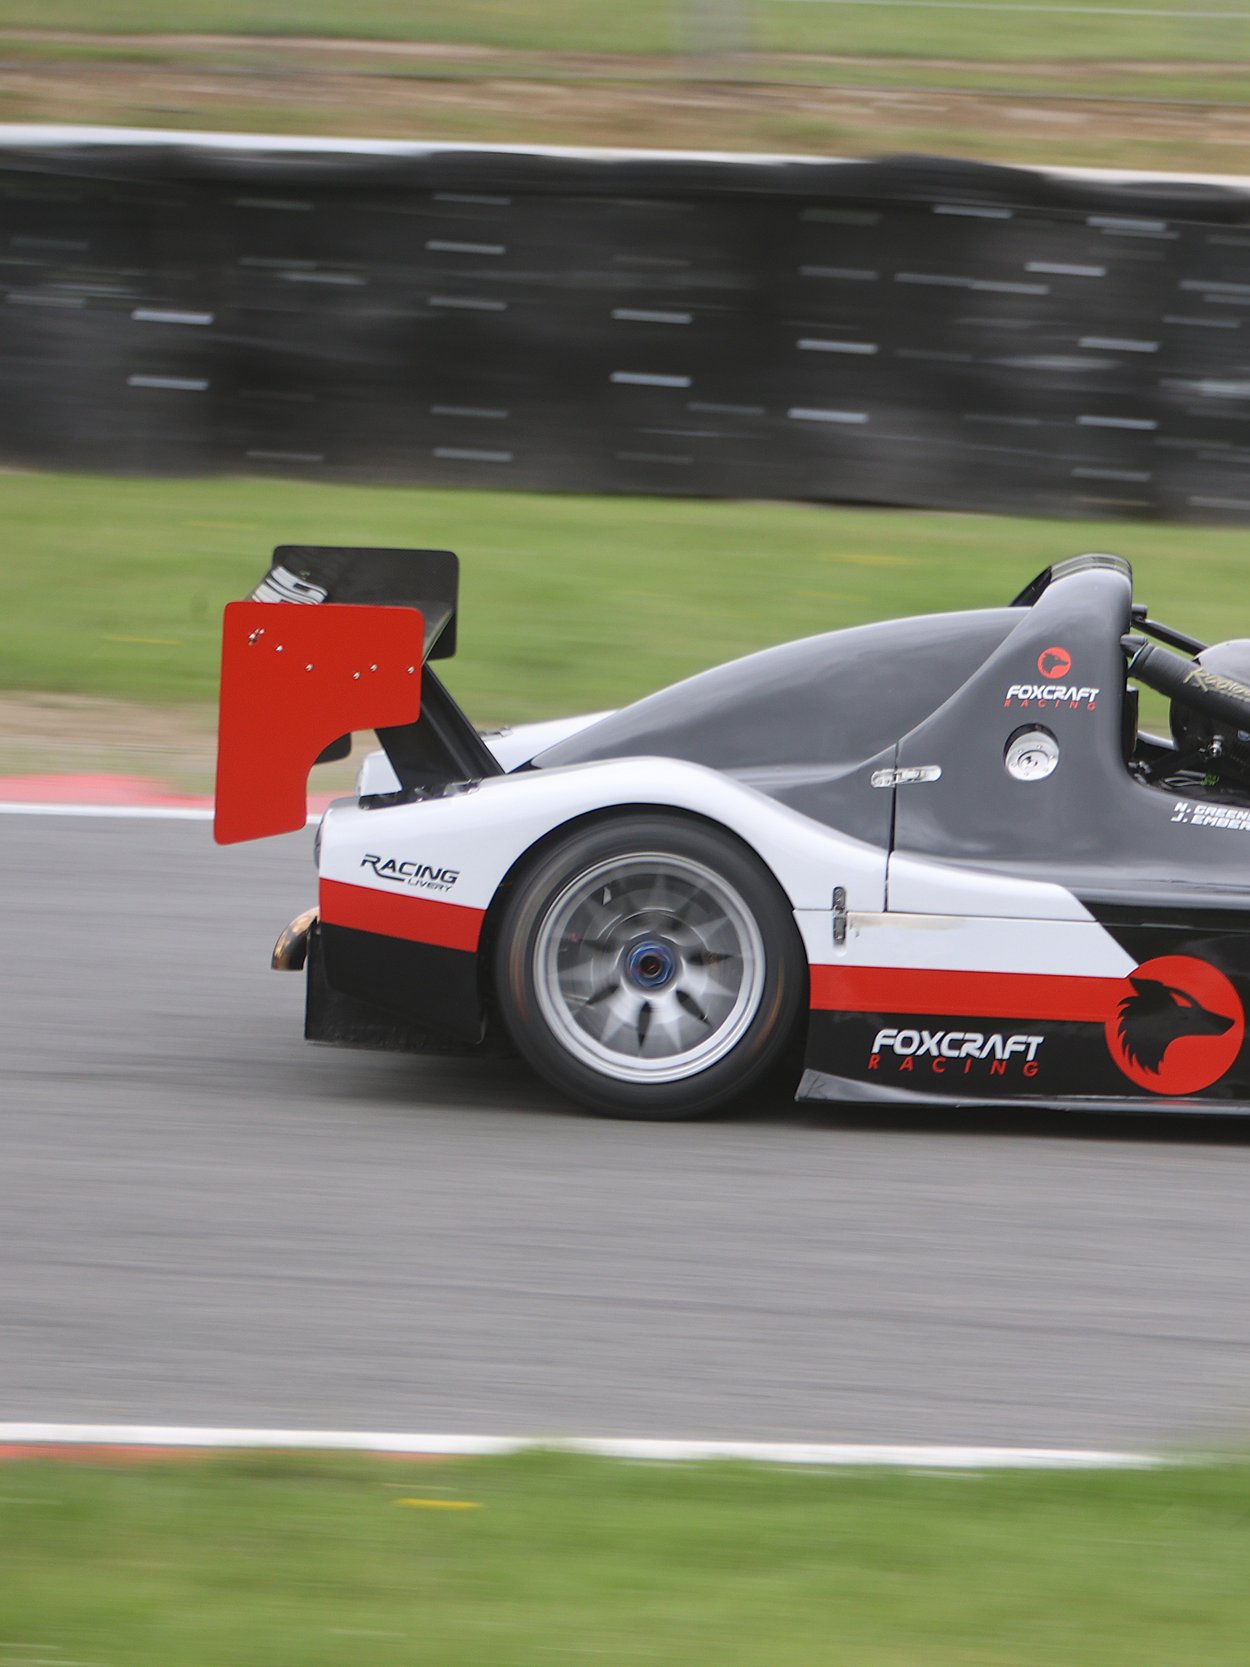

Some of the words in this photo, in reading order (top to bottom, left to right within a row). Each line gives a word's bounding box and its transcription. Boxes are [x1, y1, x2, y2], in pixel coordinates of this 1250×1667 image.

[1006, 684, 1100, 703] FOXCRAFT
[1003, 698, 1097, 711] RACING
[1170, 812, 1188, 823] J.
[360, 853, 460, 885] RACING
[407, 878, 453, 892] LIVERY
[871, 1028, 1045, 1062] FOXCRAFT
[867, 1053, 1040, 1077] RACING
